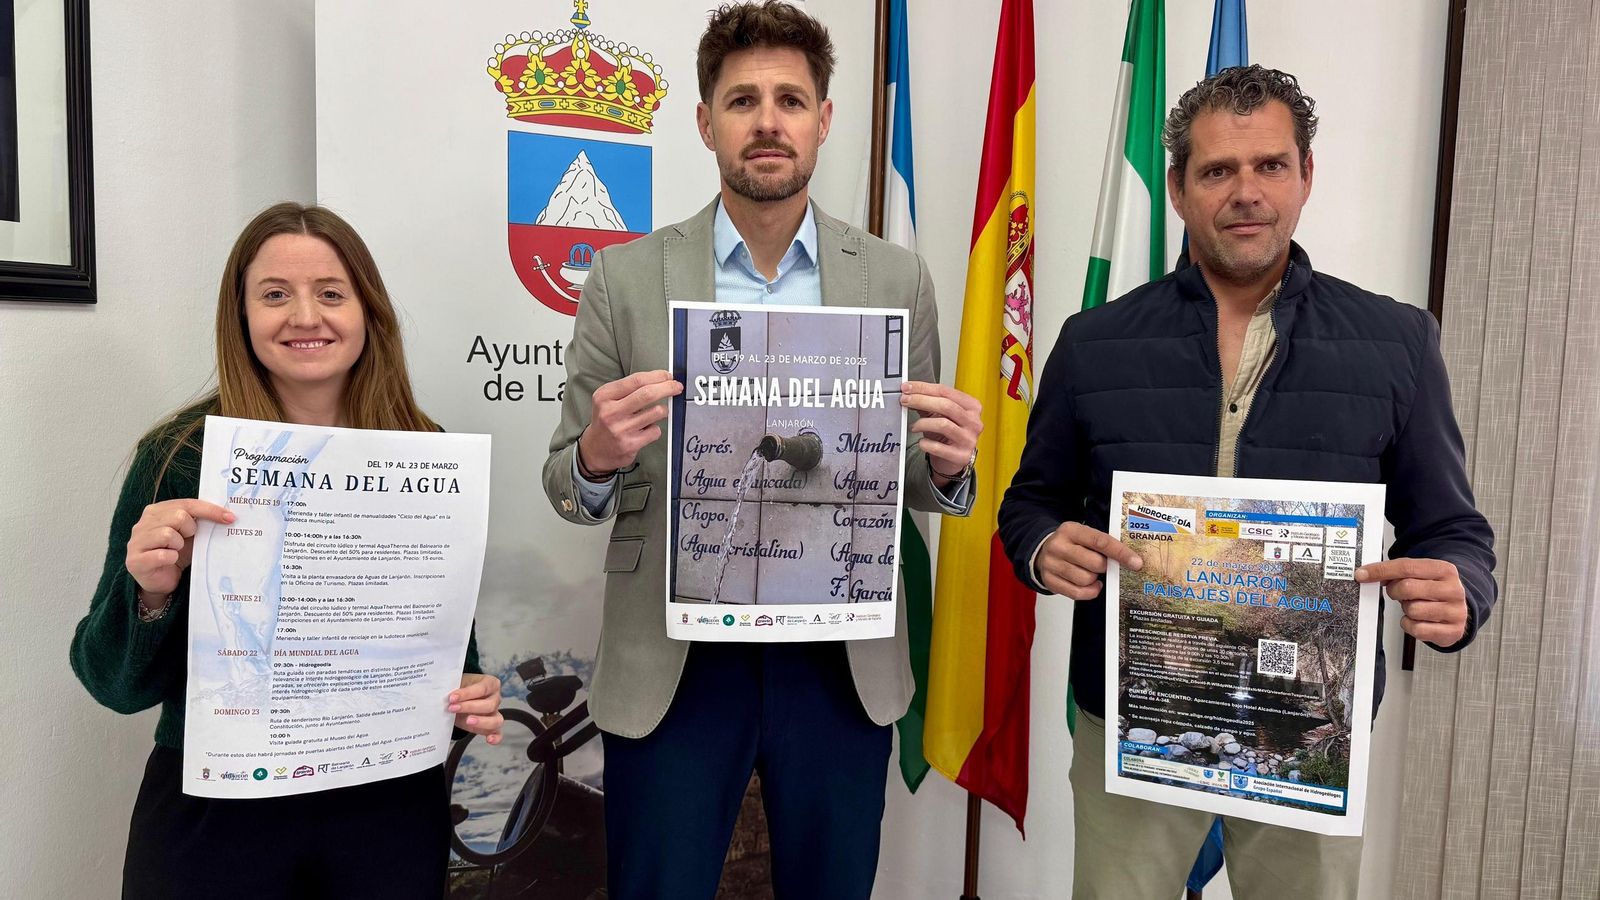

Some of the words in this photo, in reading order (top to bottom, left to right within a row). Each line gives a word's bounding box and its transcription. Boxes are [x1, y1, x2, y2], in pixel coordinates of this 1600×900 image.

[713, 353, 730, 362] DEL
[736, 354, 744, 363] 19
[764, 355, 775, 363] 23
[779, 355, 790, 363] DE
[794, 355, 826, 364] MARZO
[830, 356, 841, 365] DE
[484, 374, 524, 402] de
[694, 375, 781, 407] SEMANA
[789, 378, 824, 408] DEL
[831, 379, 884, 408] AGUA
[767, 417, 814, 429] LANJARÓN
[686, 434, 732, 460] Ciprés.
[836, 433, 900, 454] Mimbr
[234, 448, 310, 465] Programación
[231, 467, 333, 490] SEMANA
[345, 475, 389, 492] DEL
[400, 477, 460, 493] AGUA
[685, 469, 726, 495] (Agua
[733, 471, 807, 490] eancada)
[834, 471, 879, 499] (Agua
[877, 480, 898, 499] p
[229, 496, 271, 505] MIÉRCOLES
[682, 502, 728, 528] Chopo.
[833, 509, 893, 528] Corazón
[1130, 532, 1173, 542] GRANADA
[1247, 527, 1273, 536] CSIC
[681, 534, 720, 561] (Agua
[729, 539, 803, 560] cristalina)
[831, 542, 873, 572] (Agua
[1207, 559, 1218, 567] de
[1223, 562, 1254, 572] marzo
[831, 575, 844, 598] F.
[1186, 570, 1287, 591] LANJARON
[1144, 582, 1229, 602] PAISAJES
[1236, 592, 1271, 607] DEL
[1276, 595, 1332, 613] AGUA
[218, 648, 248, 656] SÁBADO
[1157, 692, 1192, 701] ENCUENTRO:
[1194, 698, 1230, 706] Aparcamientos
[1124, 742, 1161, 752] COLABORAN:
[1276, 782, 1303, 792] Internacional
[1310, 789, 1341, 799] Hidrogeólogos
